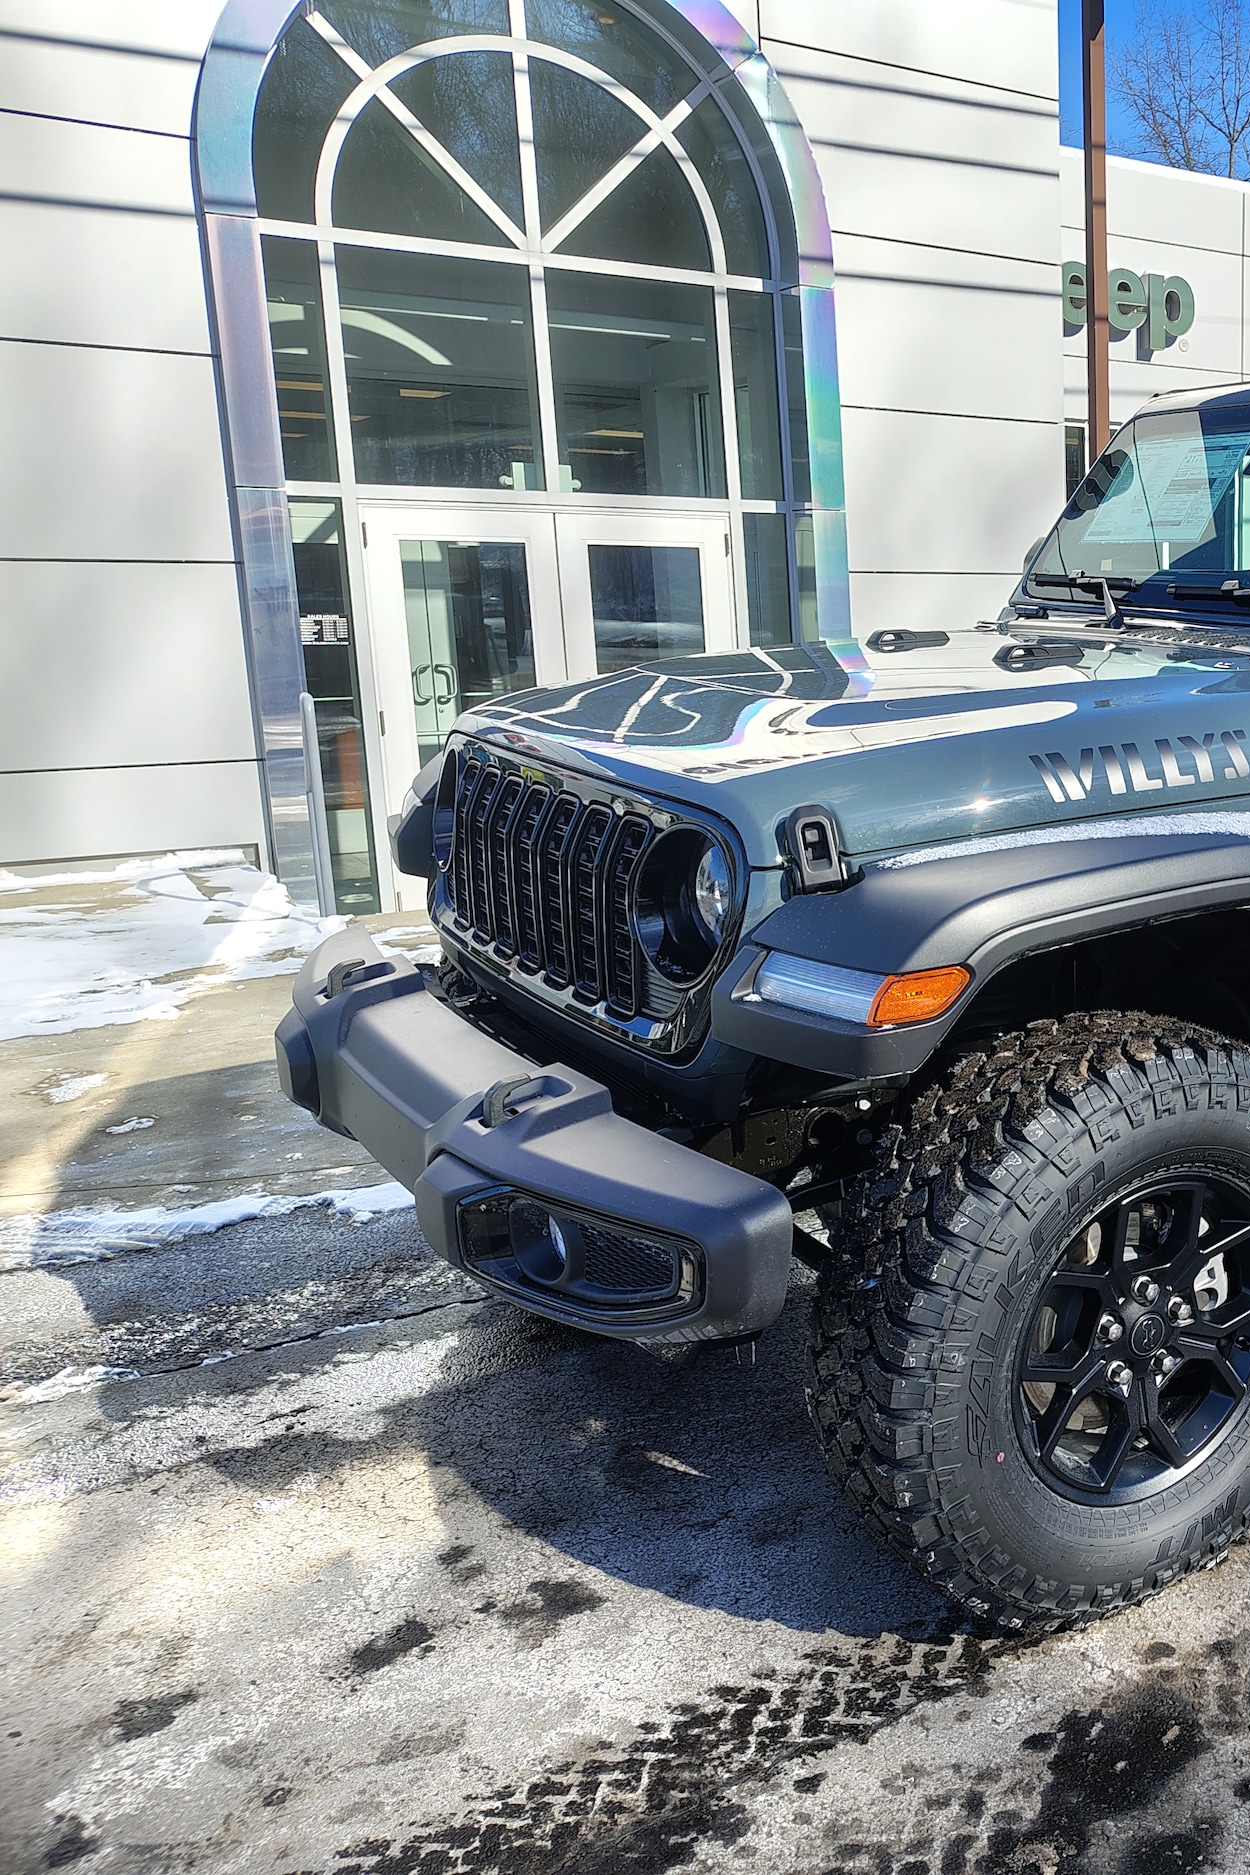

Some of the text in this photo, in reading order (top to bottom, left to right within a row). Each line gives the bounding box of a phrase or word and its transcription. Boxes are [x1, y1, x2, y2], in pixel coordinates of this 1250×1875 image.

[1062, 261, 1195, 351] eep
[1028, 729, 1250, 803] WILLYS
[966, 1158, 1106, 1469] FALKEN
[1078, 1550, 1141, 1568] MT01
[1144, 1485, 1242, 1571] M/T
